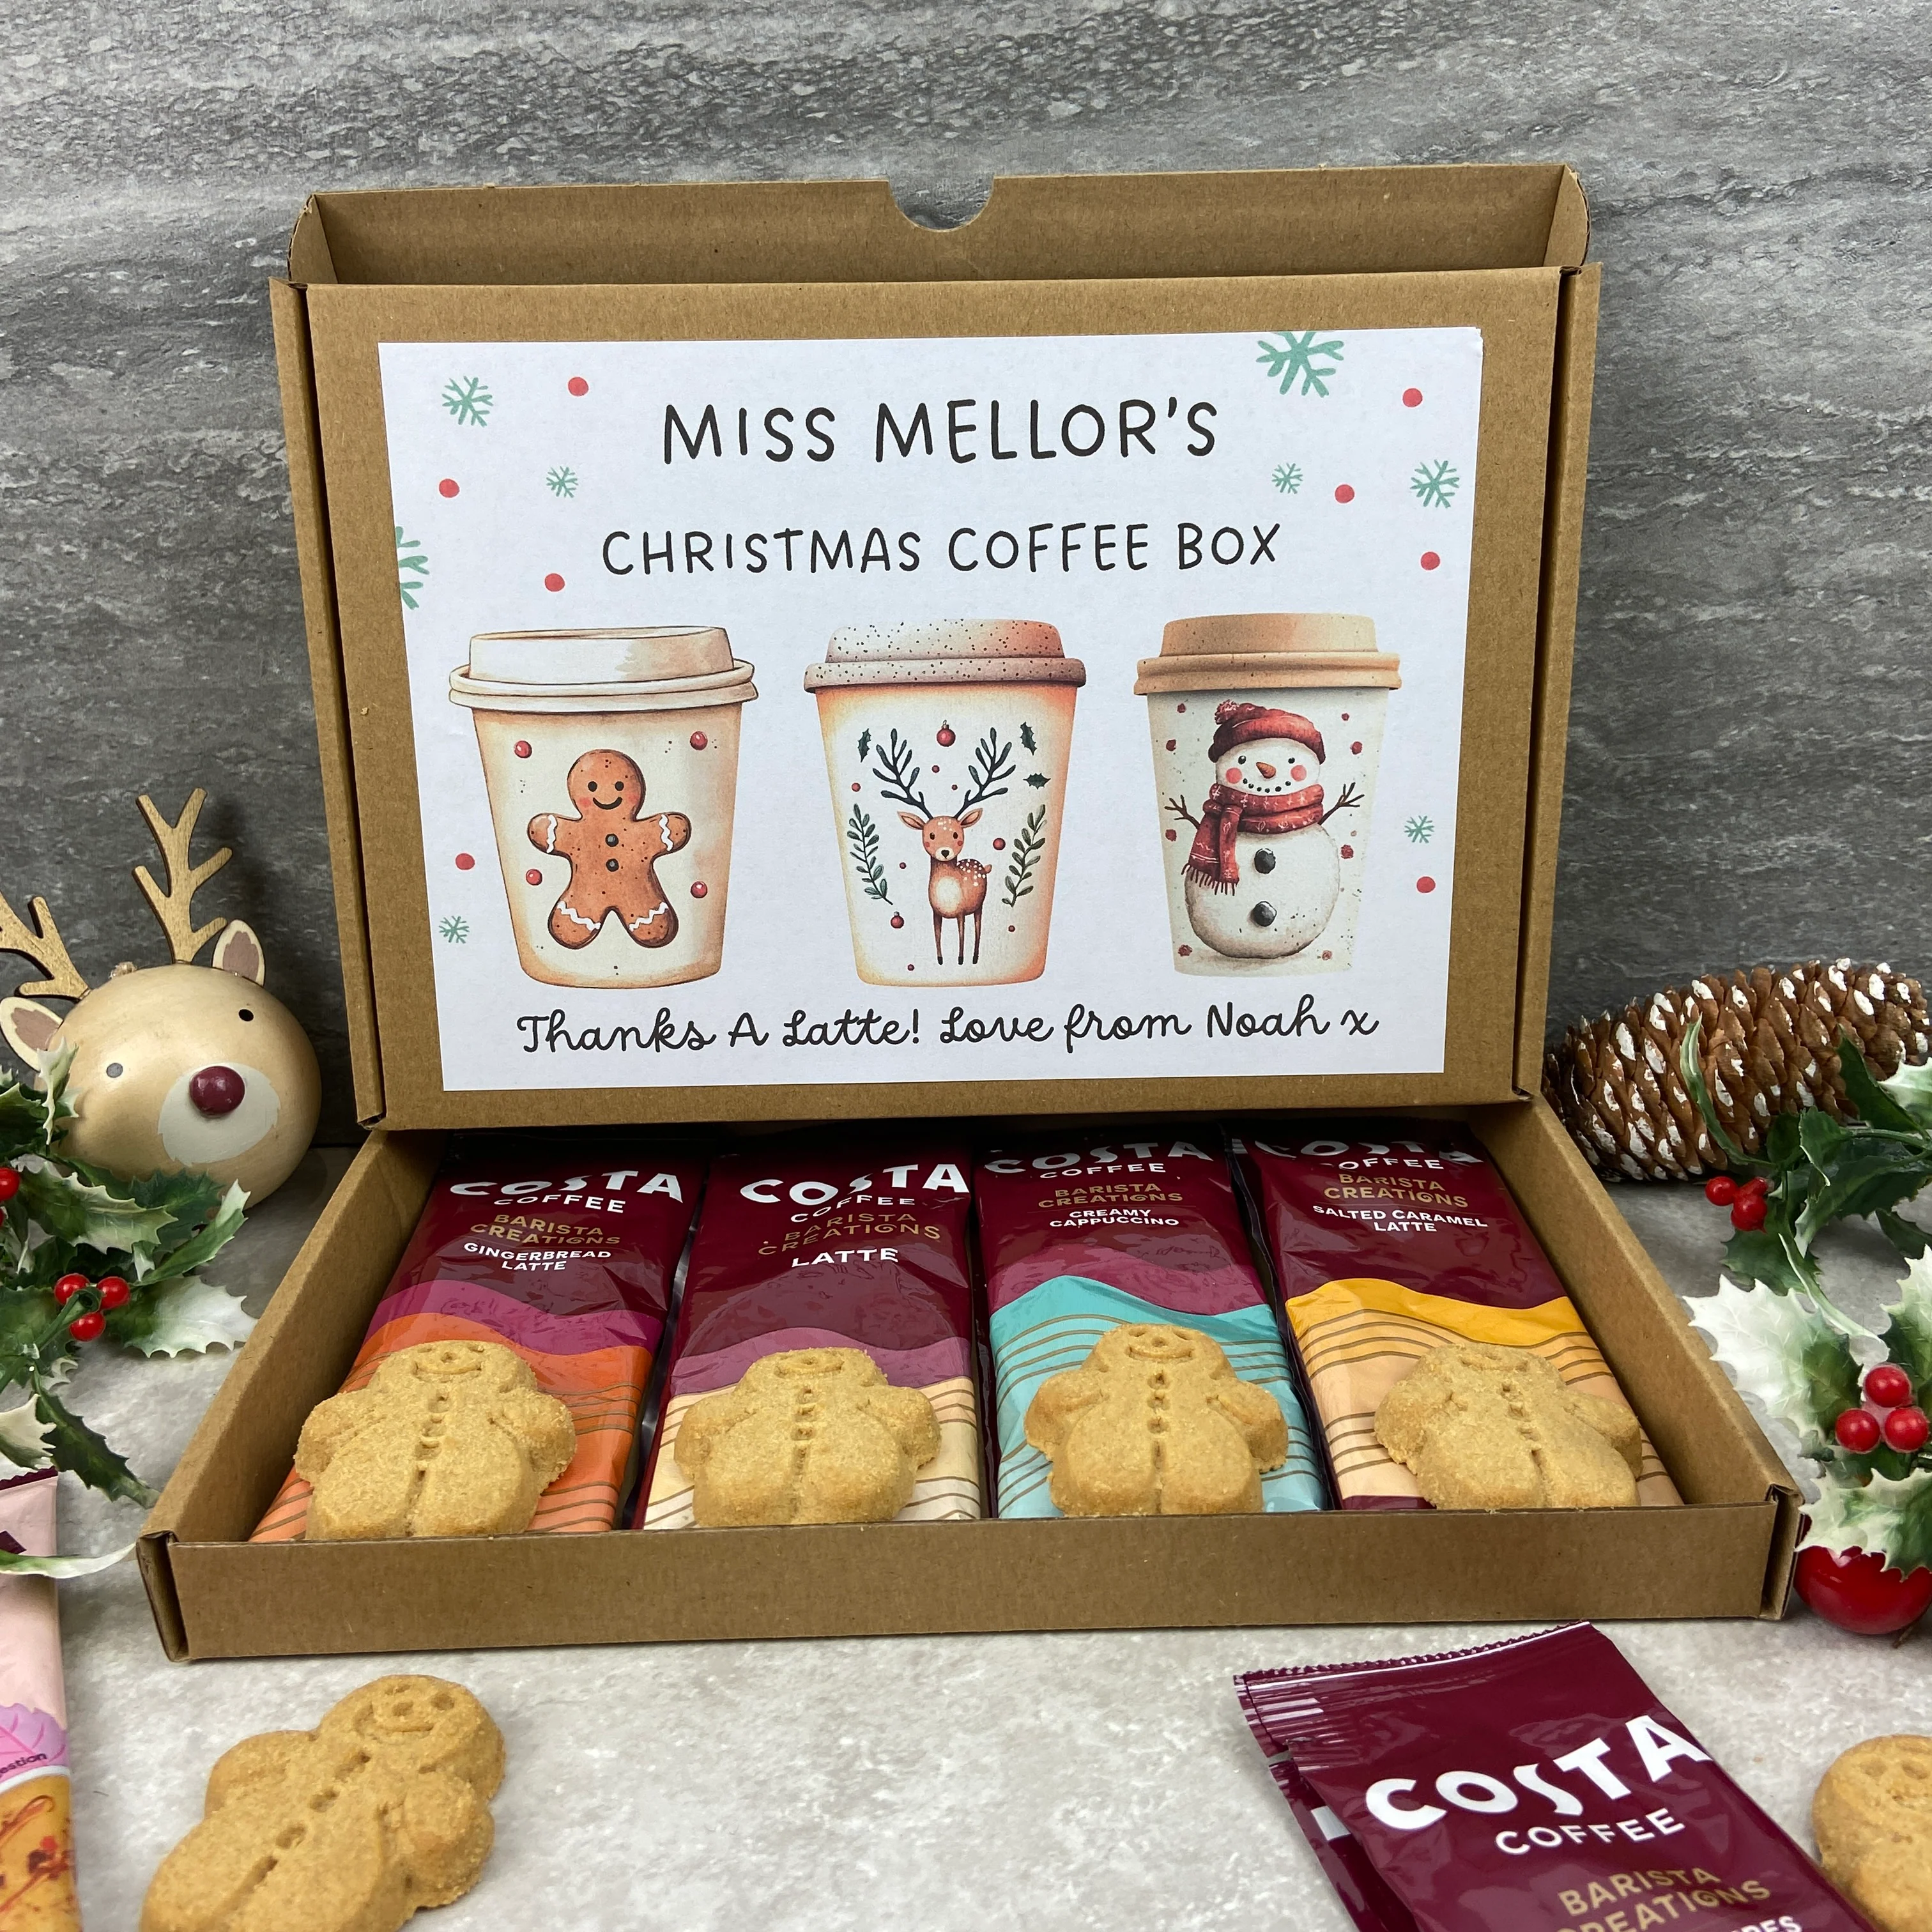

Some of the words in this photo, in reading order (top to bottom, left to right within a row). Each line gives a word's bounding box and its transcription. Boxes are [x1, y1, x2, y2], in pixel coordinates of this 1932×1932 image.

[662, 401, 837, 466] MISS
[871, 395, 1219, 466] MELLOR'S
[601, 527, 923, 578] CHRISTMAS
[947, 521, 1150, 575] COFFEE
[1176, 521, 1282, 572] BOX
[516, 1007, 716, 1052] Thanks
[726, 1011, 769, 1048] A
[782, 1006, 921, 1046] Latte!
[939, 1004, 1054, 1044] Love
[1064, 1003, 1192, 1054] from
[1206, 992, 1332, 1039] Noah
[1340, 1006, 1380, 1036] x
[983, 1140, 1215, 1174] COSTA
[1320, 1157, 1445, 1170] OFFEE
[1039, 1162, 1167, 1179] COFFEE
[449, 1169, 684, 1204] COSTA
[739, 1163, 970, 1206] COSTA
[1054, 1183, 1163, 1198] BARISTA
[1338, 1173, 1446, 1192] BARISTA
[493, 1193, 627, 1214] COFFEE
[790, 1195, 916, 1223] COFFEE
[1038, 1192, 1184, 1209] CREATIONS
[1323, 1186, 1469, 1209] CREATIONS
[1048, 1216, 1180, 1227] CAPPUCCINO
[1068, 1208, 1152, 1218] CREAMY
[1312, 1205, 1386, 1221] SALTED
[1391, 1209, 1489, 1229] CARAMEL
[469, 1223, 621, 1246] CREATIONS
[493, 1213, 604, 1237] BARISTA
[783, 1213, 917, 1242] BARISTA
[1373, 1222, 1438, 1232] LATTE
[757, 1223, 942, 1256] CREATIONS
[463, 1241, 612, 1262] GINGERBREAD
[790, 1246, 900, 1269] LATTE
[500, 1261, 567, 1272] LATTE
[0, 1753, 48, 1776] estion
[1364, 1714, 1713, 1832] COSTA
[1494, 1807, 1685, 1857] COFFEE
[1557, 1866, 1721, 1917] BARISTA
[1557, 1878, 1771, 1932] EATIONS
